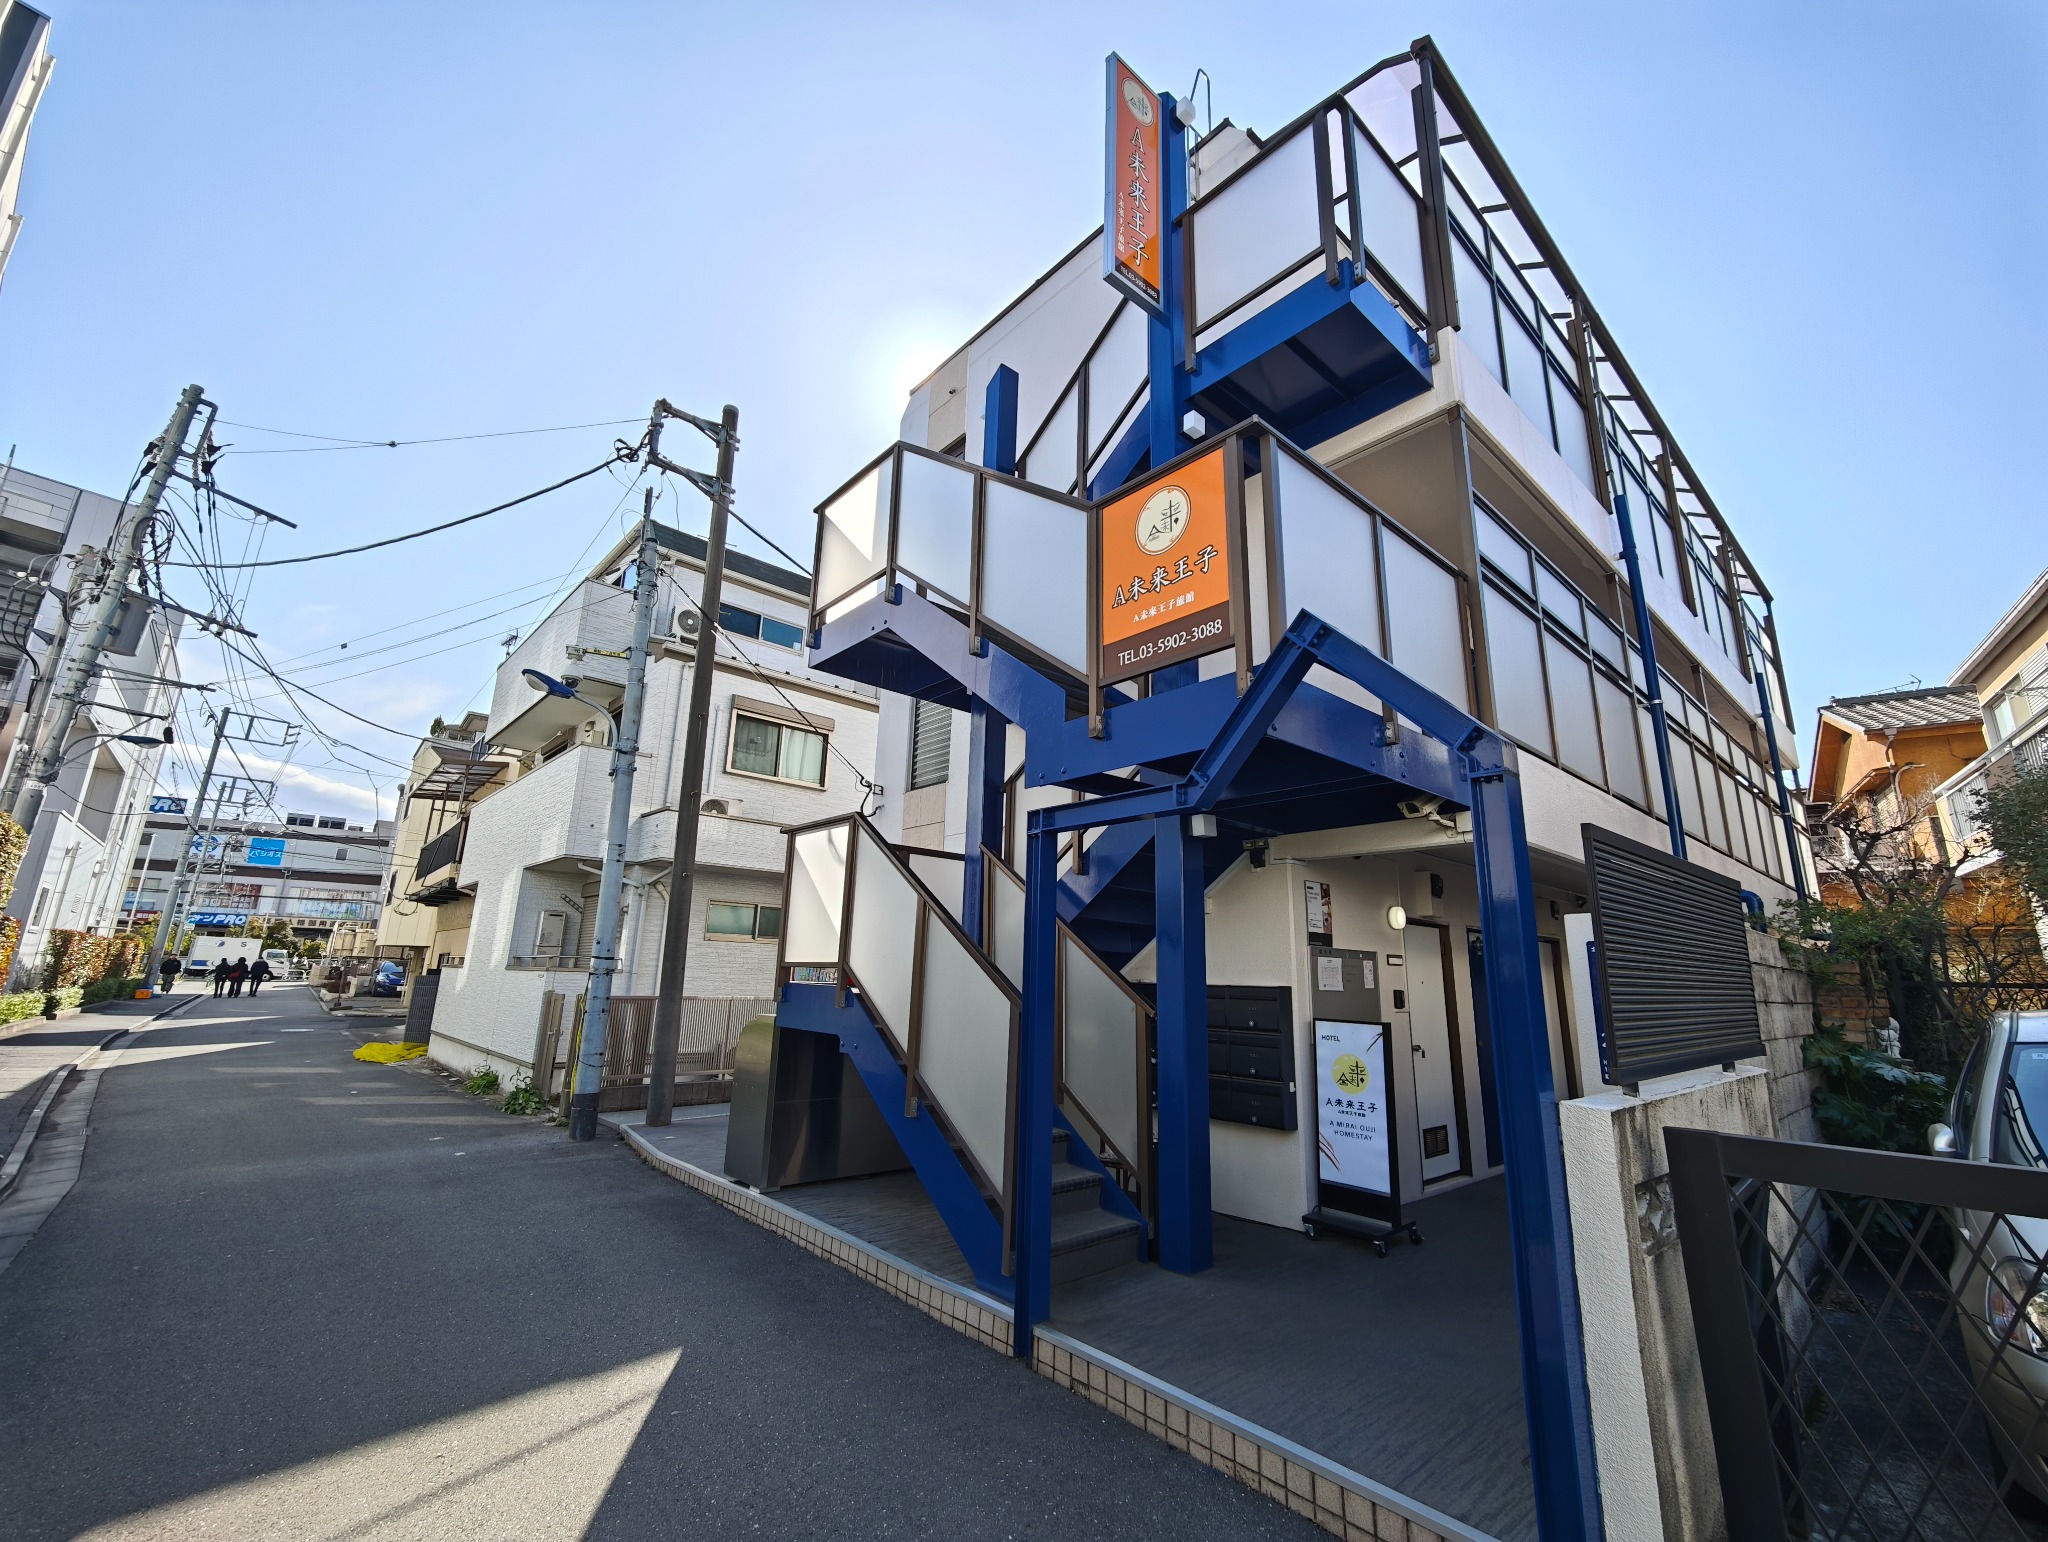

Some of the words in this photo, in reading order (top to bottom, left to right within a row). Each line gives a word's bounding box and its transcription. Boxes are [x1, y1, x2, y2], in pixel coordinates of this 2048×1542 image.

[1111, 544, 1219, 609] A未来王子
[1117, 618, 1223, 666] TEL.03-5902-3088
[1321, 1034, 1341, 1042] HOTEL
[1336, 1121, 1357, 1130] MIRAI
[1359, 1124, 1377, 1133] OUJI
[1333, 1129, 1373, 1142] HOMESTAY
